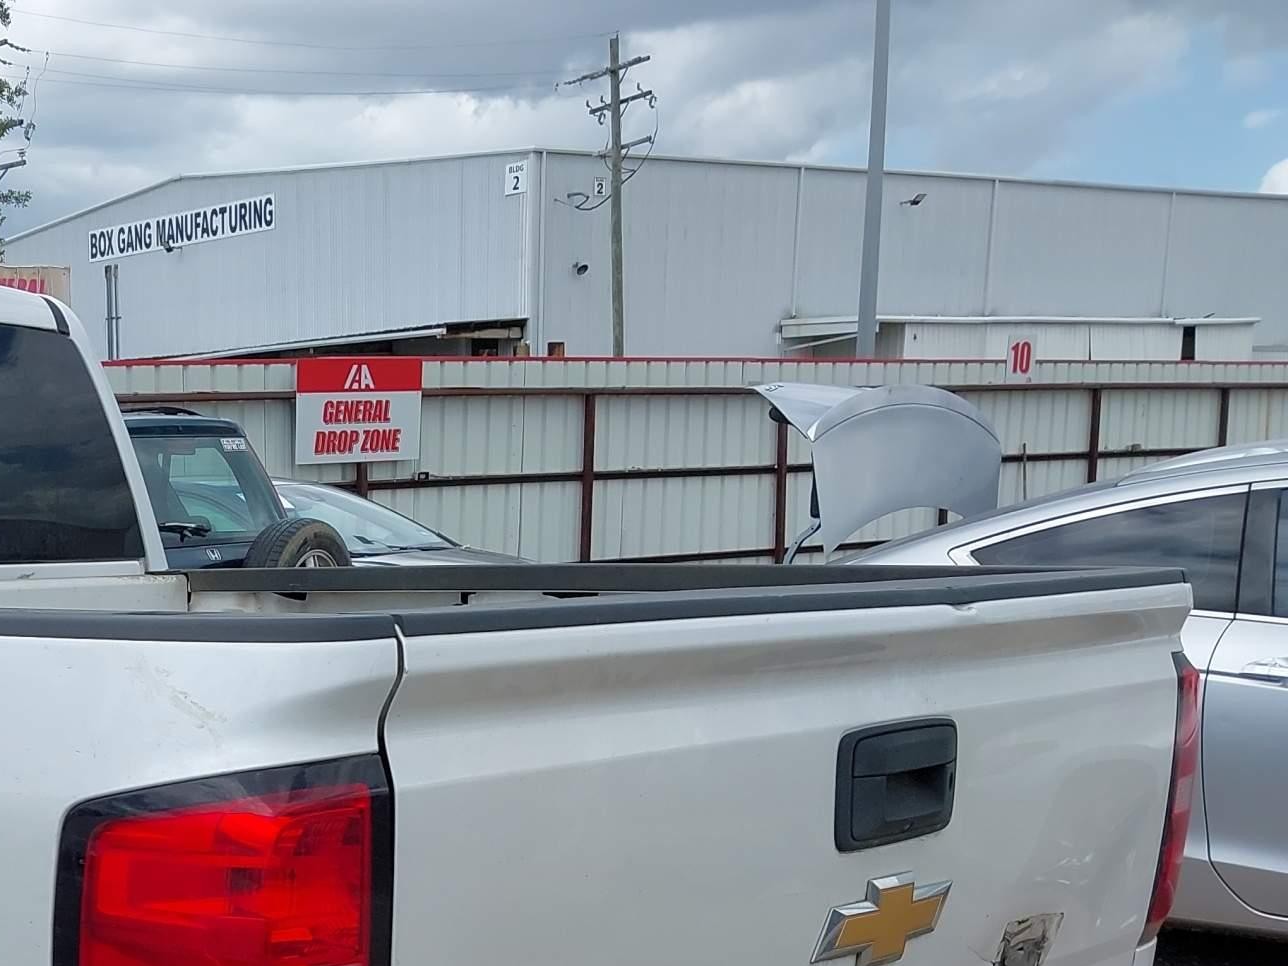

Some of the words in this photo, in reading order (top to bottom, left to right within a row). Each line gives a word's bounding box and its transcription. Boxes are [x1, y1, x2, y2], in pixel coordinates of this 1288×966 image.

[508, 164, 525, 174] BLDG
[512, 175, 520, 191] 2
[596, 182, 604, 195] 2
[89, 229, 115, 260] BOX
[117, 221, 152, 255] GANG
[156, 196, 274, 248] MANUFACTURING
[1010, 340, 1032, 375] 10
[322, 400, 391, 425] GENERAL
[314, 430, 360, 456] DROP
[359, 428, 401, 454] ZONE
